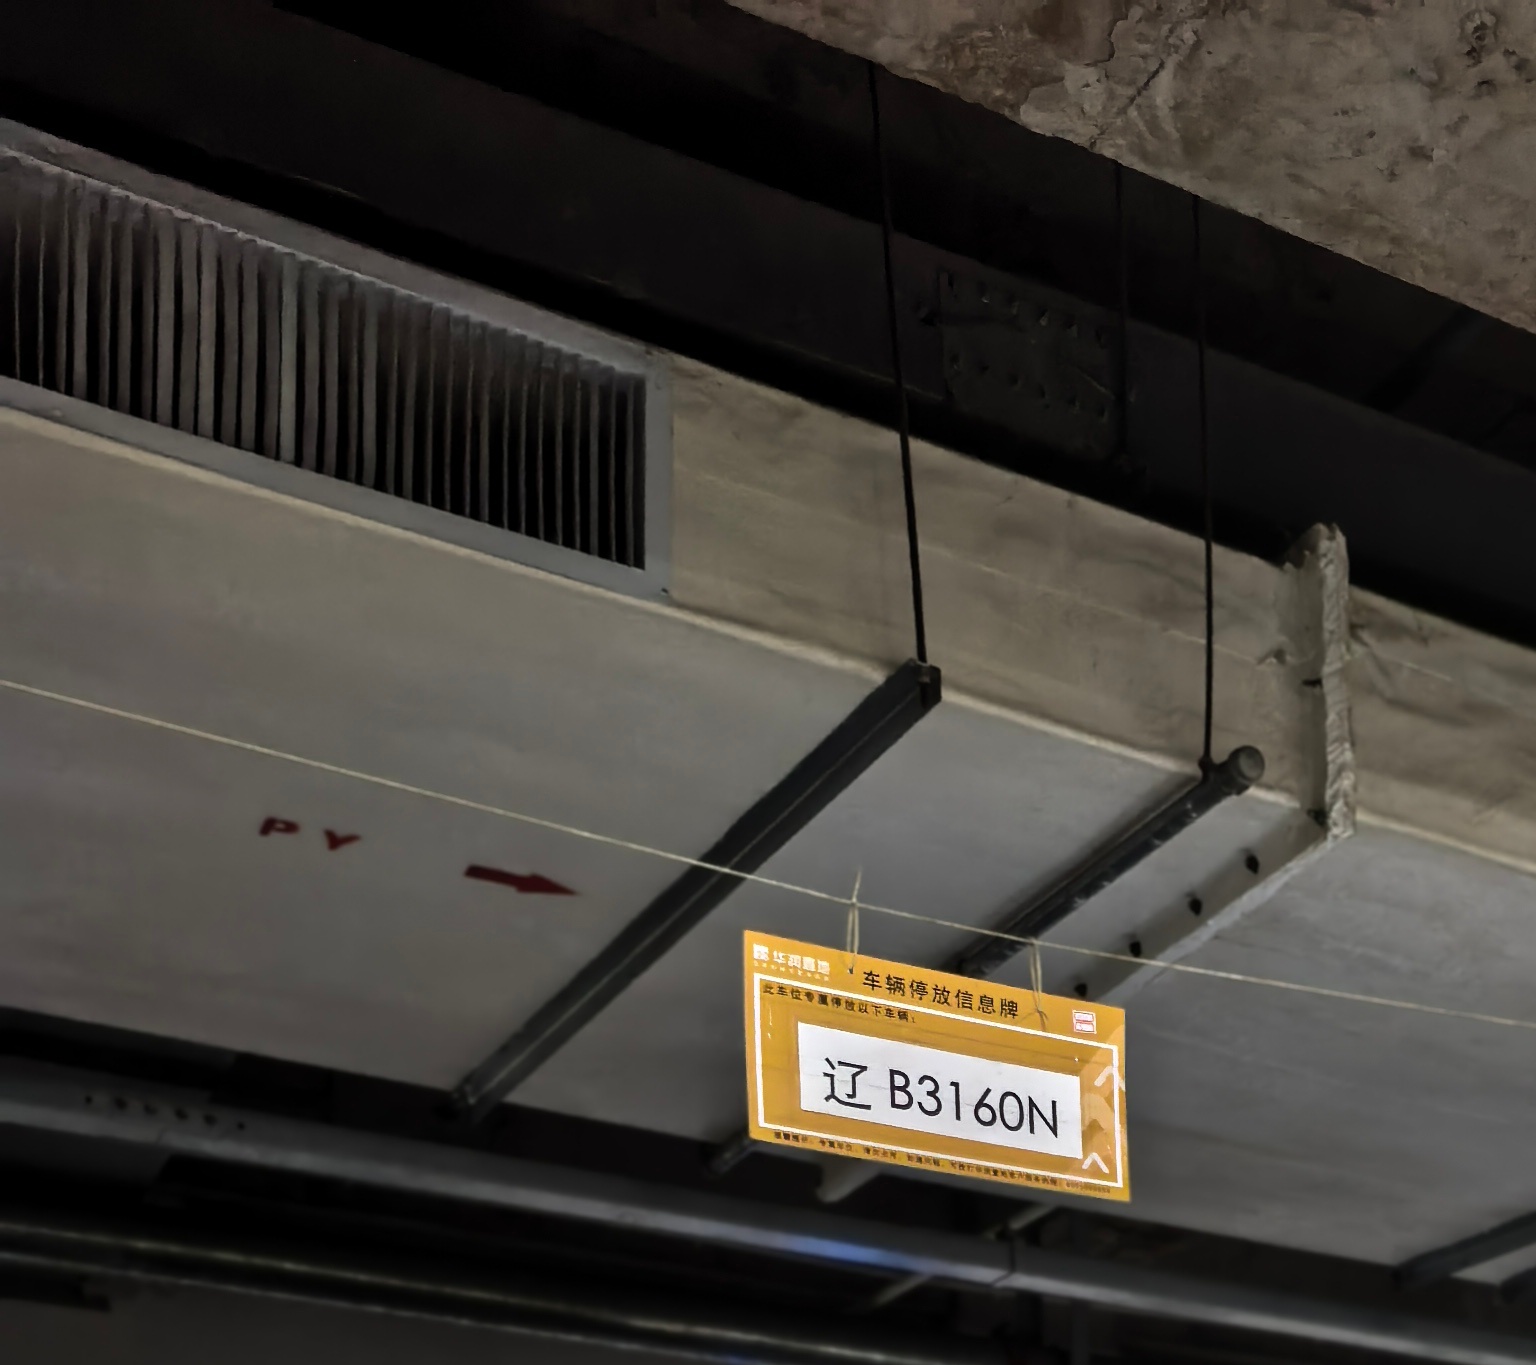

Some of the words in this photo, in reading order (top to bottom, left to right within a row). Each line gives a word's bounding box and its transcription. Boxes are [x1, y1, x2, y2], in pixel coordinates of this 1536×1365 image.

[861, 970, 1020, 1020] 车辆停放信息牌
[822, 1057, 872, 1111] 辽
[889, 1068, 1059, 1139] B3160N
